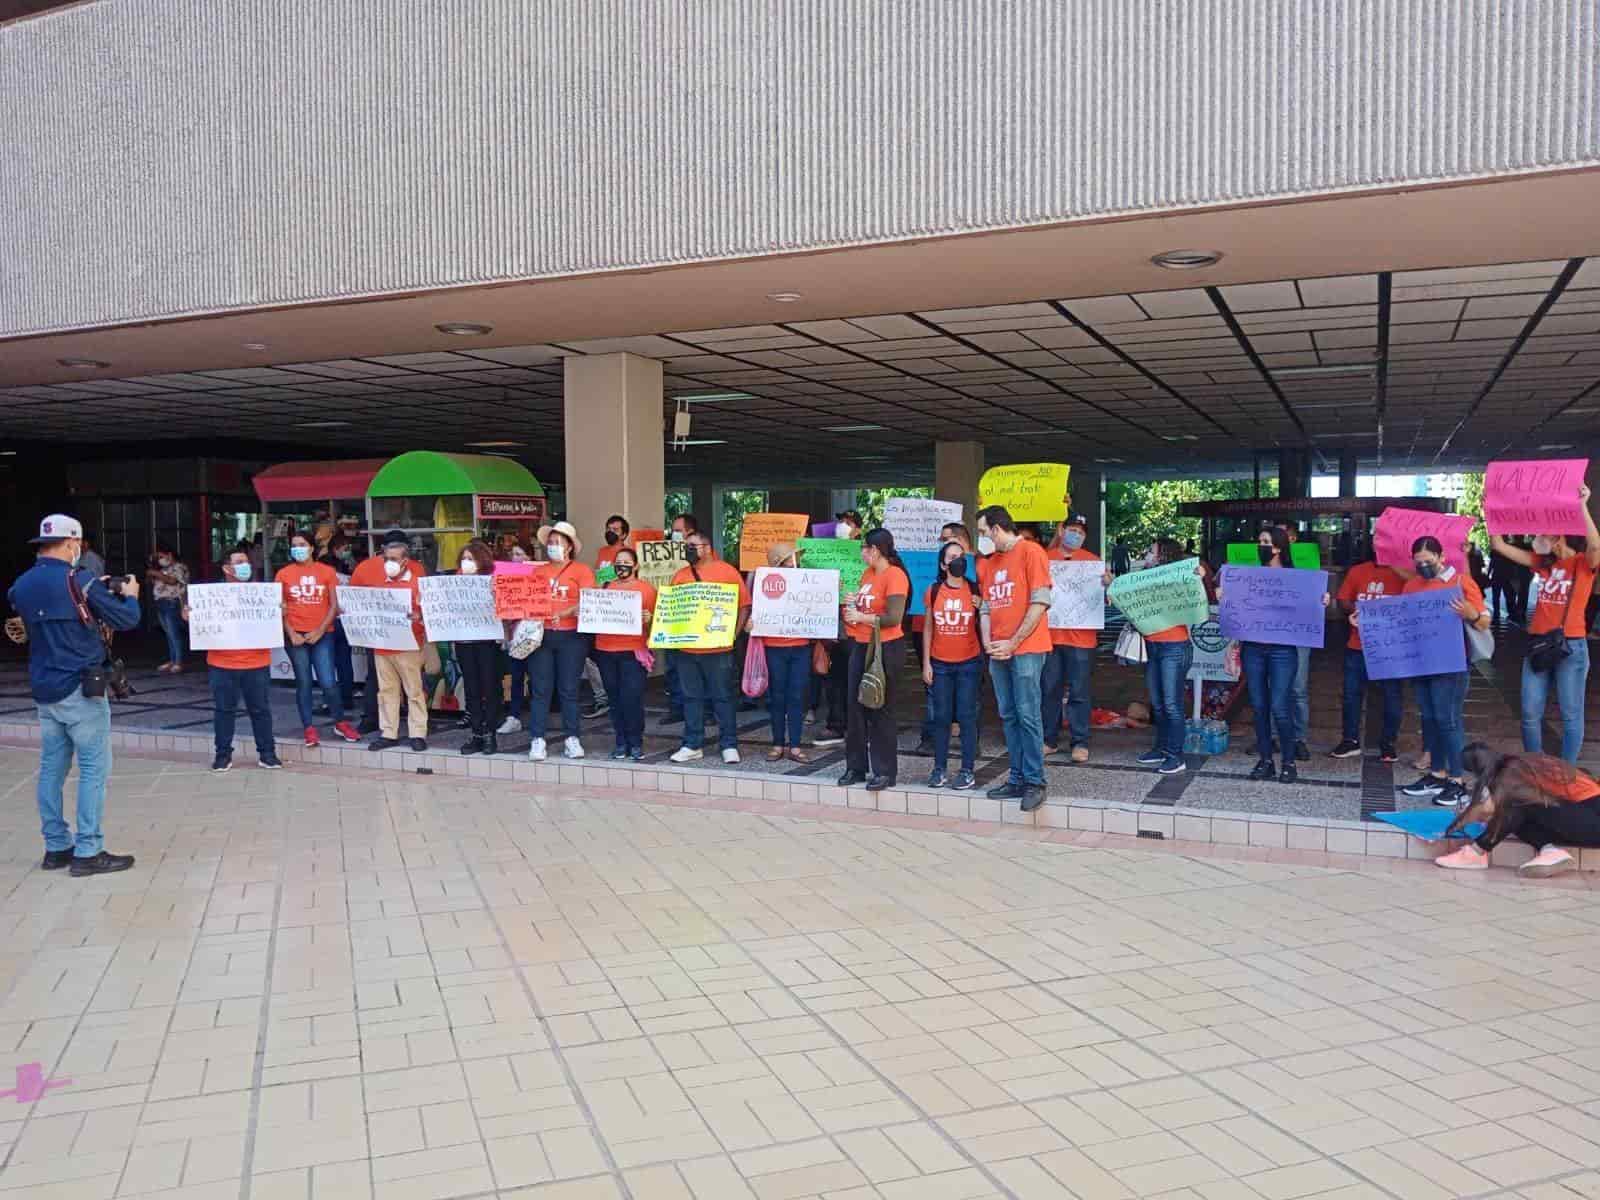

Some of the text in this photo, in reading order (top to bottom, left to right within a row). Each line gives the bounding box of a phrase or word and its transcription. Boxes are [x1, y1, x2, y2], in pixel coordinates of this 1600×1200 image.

[290, 584, 325, 598] SUT
[763, 579, 785, 593] ALTO
[989, 582, 1015, 601] SUT
[934, 611, 973, 626] SUT
